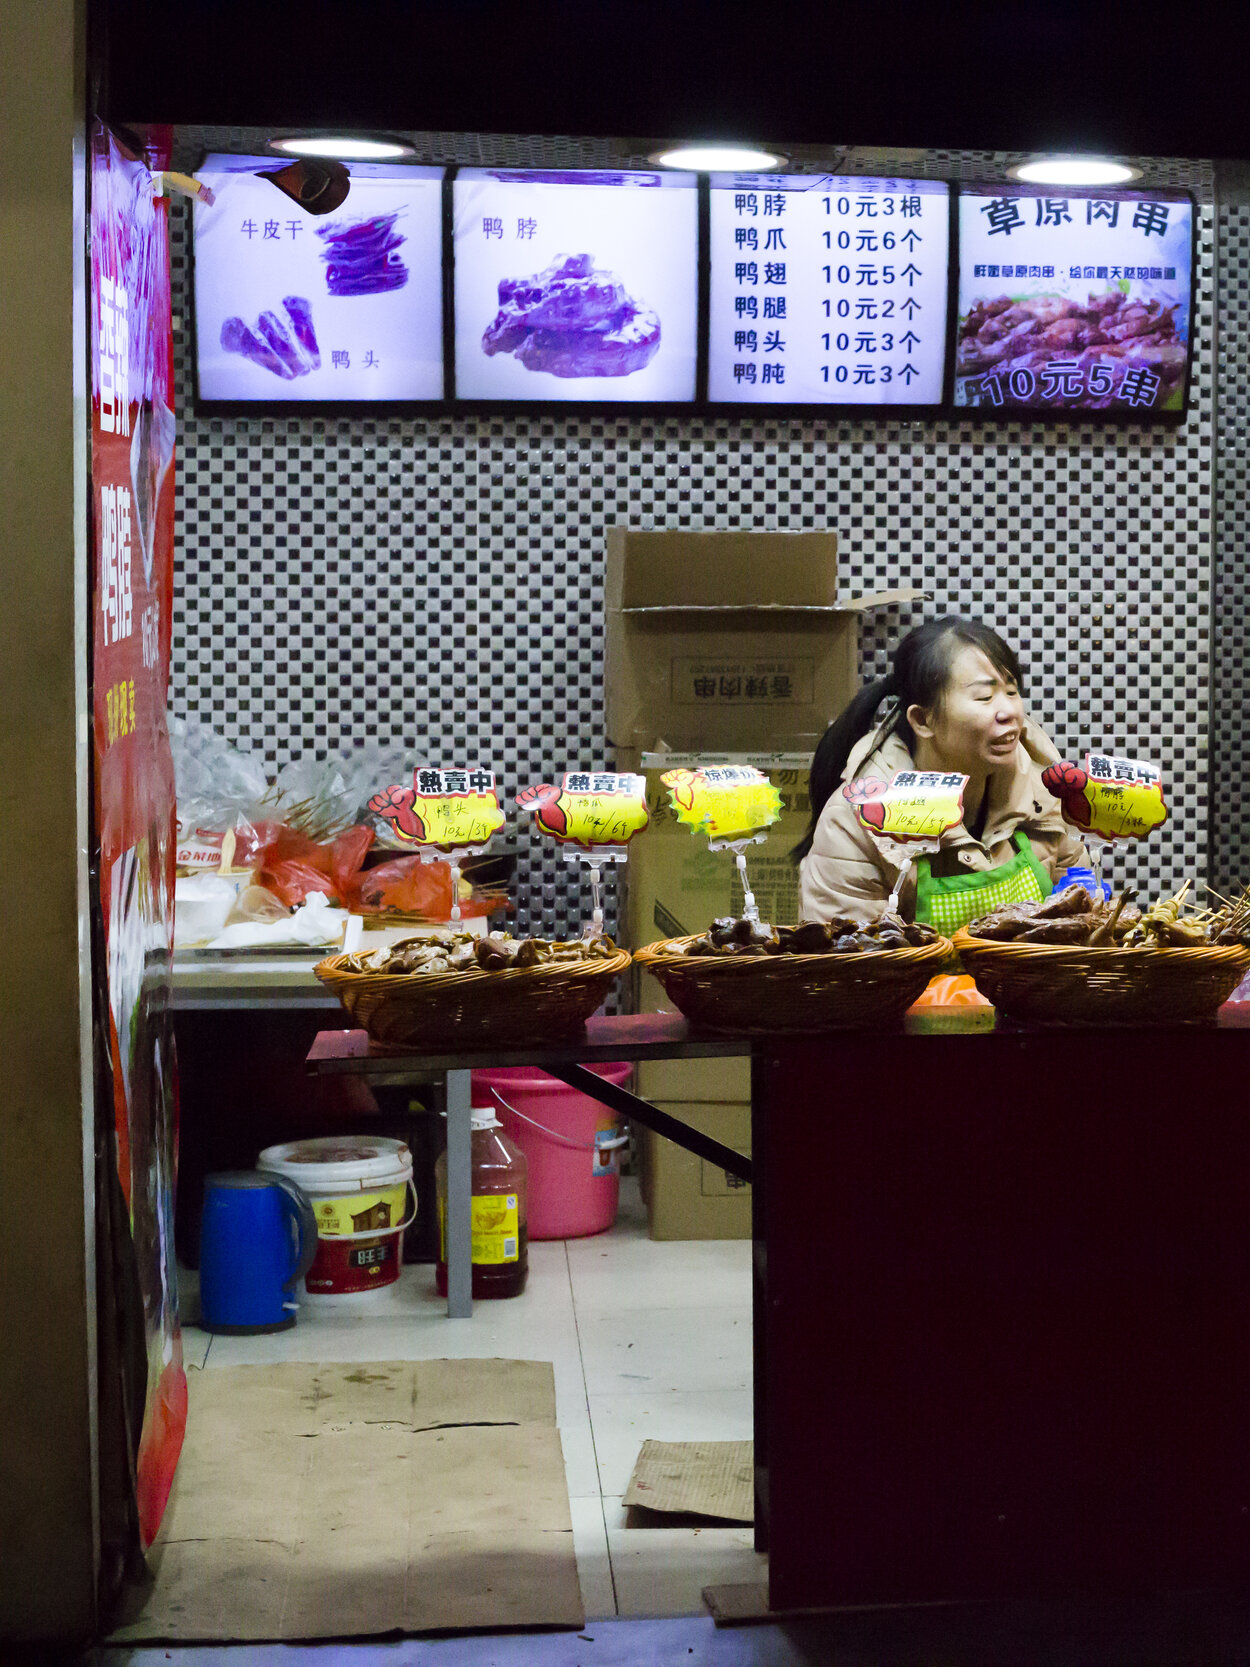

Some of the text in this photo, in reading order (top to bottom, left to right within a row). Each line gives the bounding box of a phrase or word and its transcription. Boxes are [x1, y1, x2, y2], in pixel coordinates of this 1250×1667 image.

[734, 193, 923, 218] 鸭脖 10元3根
[980, 198, 1170, 237] 草原肉串
[240, 218, 304, 240] 牛皮干
[482, 217, 538, 240] 鸭脖
[735, 227, 922, 253] 鸭爪 10元6个
[735, 261, 922, 287] 鸭翅 10元5个
[735, 295, 922, 321] 鸭腿 10元2个
[734, 329, 921, 354] 鸭头 10元3个
[331, 349, 380, 369] 鸭头
[733, 363, 920, 386] 鸭肫 10元3个
[981, 361, 1160, 407] 10元5串
[693, 676, 793, 699] 香辣肉串
[419, 770, 492, 793] 熱賣中
[894, 772, 964, 789] 熱賣中
[1091, 757, 1158, 784] 熱賣中
